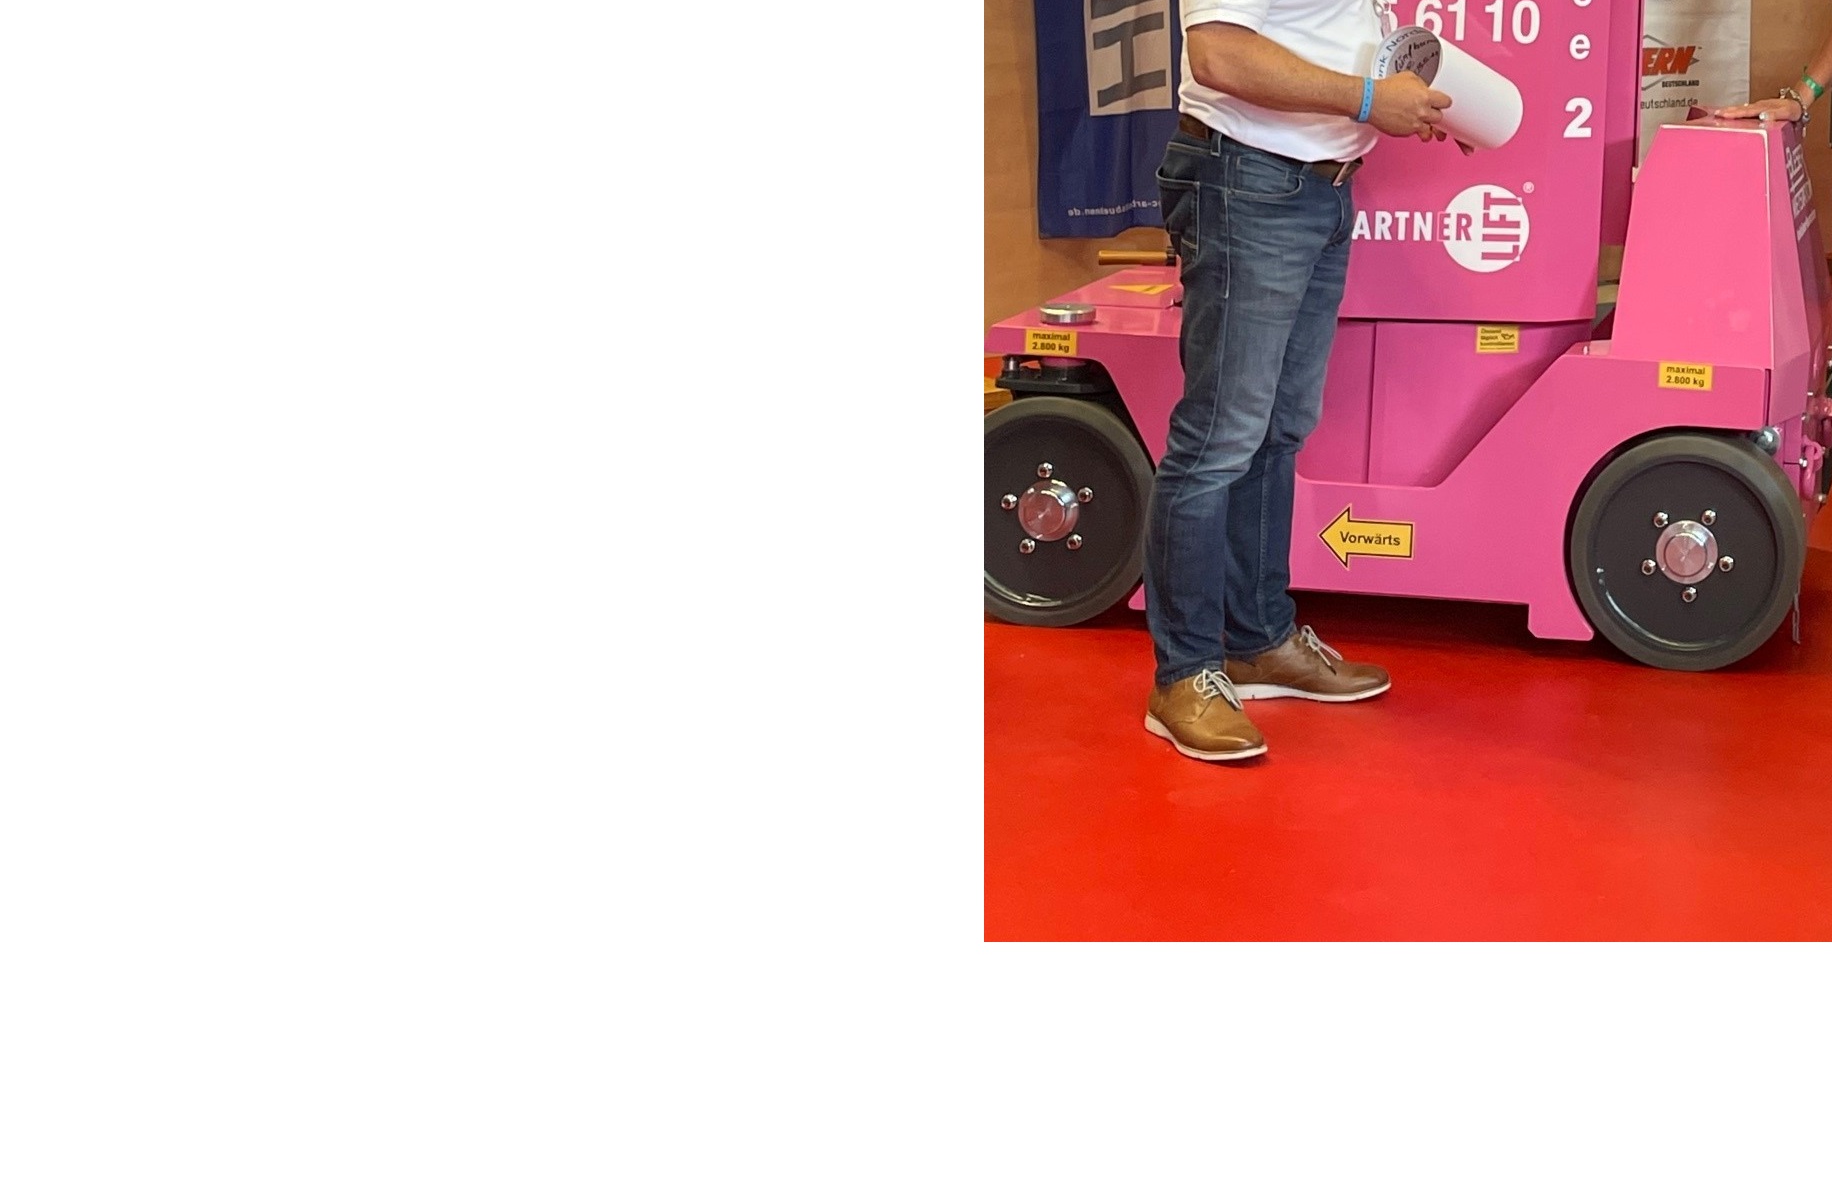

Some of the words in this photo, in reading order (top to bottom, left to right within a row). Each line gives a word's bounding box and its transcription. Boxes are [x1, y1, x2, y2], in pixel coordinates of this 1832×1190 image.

[1485, 0, 1541, 44] 10
[1563, 97, 1593, 138] 2
[1352, 211, 1473, 242] ARTNER
[1481, 192, 1522, 261] LIFT
[1032, 331, 1071, 342] maximal
[1058, 342, 1070, 353] kg
[1666, 366, 1706, 375] maximal
[1666, 375, 1691, 384] 2.800
[1693, 377, 1705, 388] kg
[1340, 531, 1401, 546] Vorwärts
